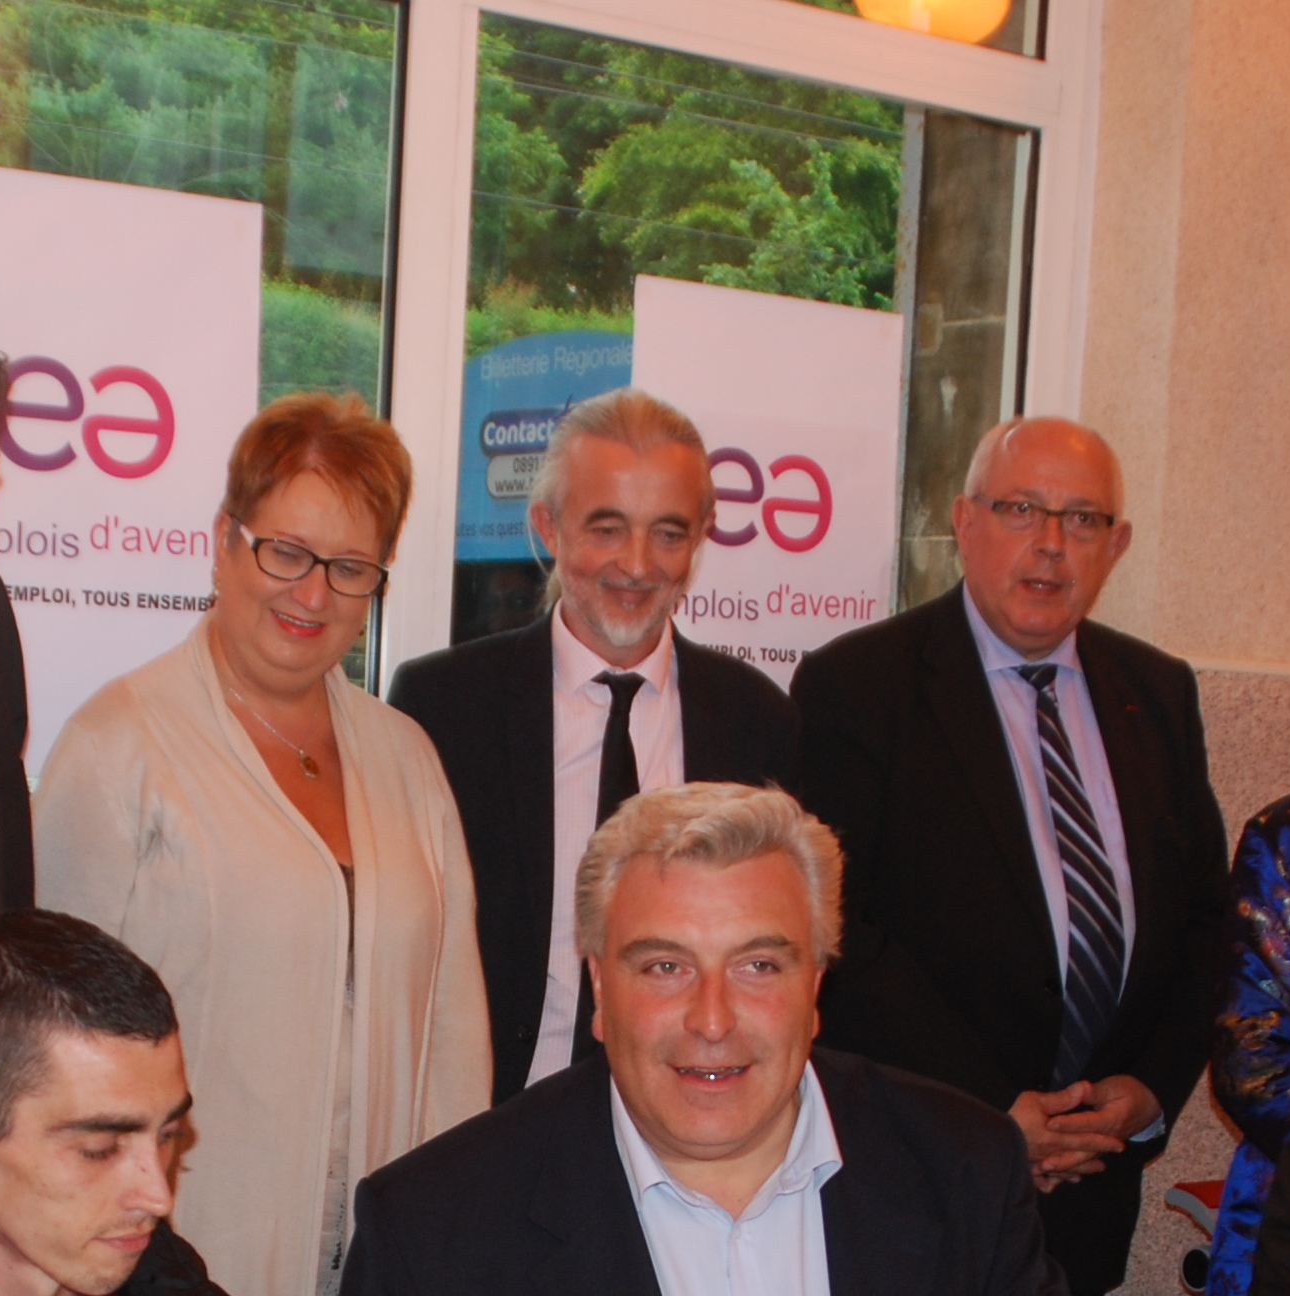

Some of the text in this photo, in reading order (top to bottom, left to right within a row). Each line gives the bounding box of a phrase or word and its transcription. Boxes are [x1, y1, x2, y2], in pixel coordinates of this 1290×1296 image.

[483, 418, 555, 447] Contact
[82, 589, 130, 608] TOUS
[766, 582, 877, 621] d'avenir
[761, 647, 797, 664] TOUS
